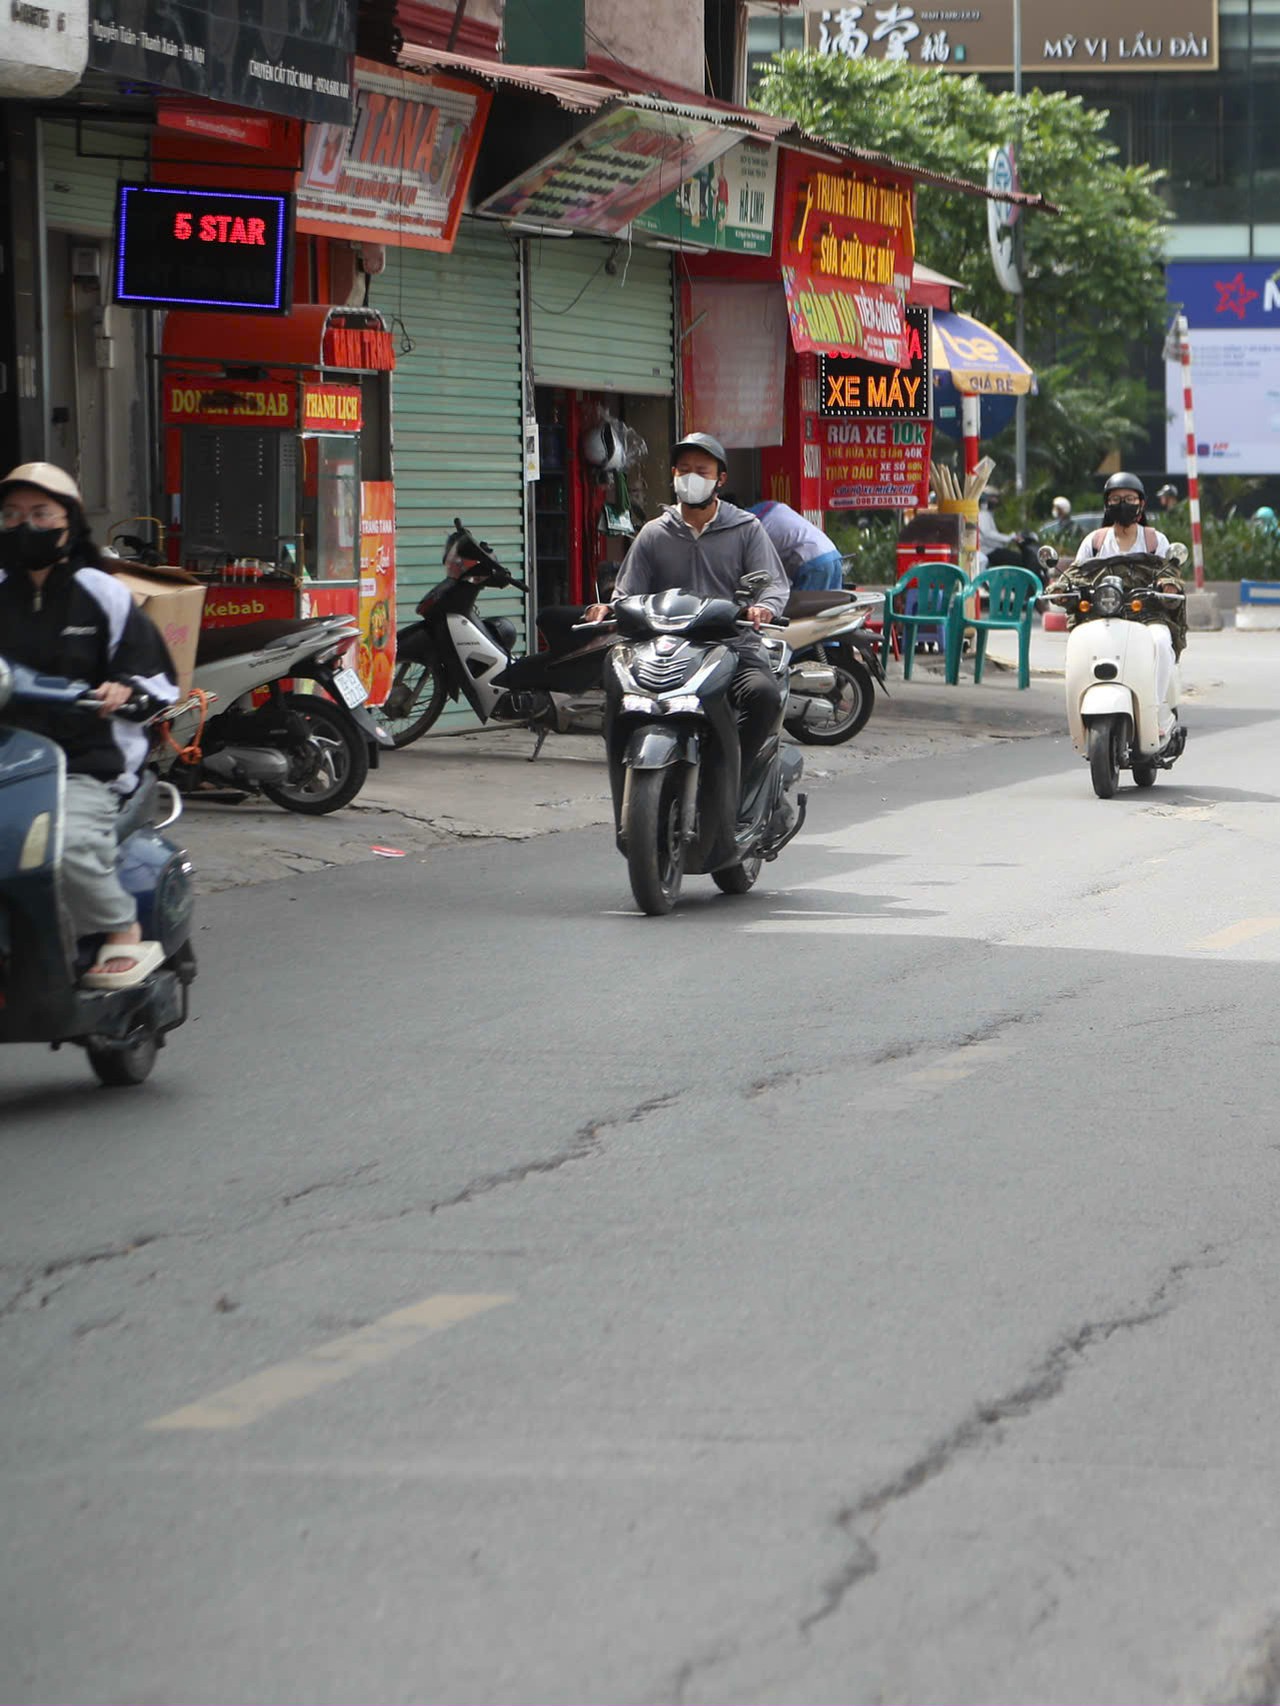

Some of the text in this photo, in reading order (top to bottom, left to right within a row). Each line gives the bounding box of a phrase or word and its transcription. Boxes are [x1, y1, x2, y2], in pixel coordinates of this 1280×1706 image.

[1084, 37, 1109, 63] VỊ
[1169, 32, 1209, 58] ĐÀI
[360, 92, 442, 175] TANA
[816, 172, 846, 216] TRUNG
[846, 170, 865, 220] TÂM
[174, 212, 266, 246] 5 STAR
[820, 222, 896, 286] SỬA CHỮA XE MÁY
[939, 327, 999, 362] be
[827, 375, 860, 407] XE
[867, 368, 921, 408] MÁY
[969, 373, 992, 391] GIÁ
[306, 392, 358, 426] THANH LỊCH
[827, 417, 927, 446] RỬA XE 10k
[866, 446, 879, 459] XE
[904, 446, 922, 459] 40K
[880, 462, 892, 471] XE
[825, 465, 849, 481] THAY
[880, 472, 892, 482] XE
[204, 600, 265, 617] Kebab
